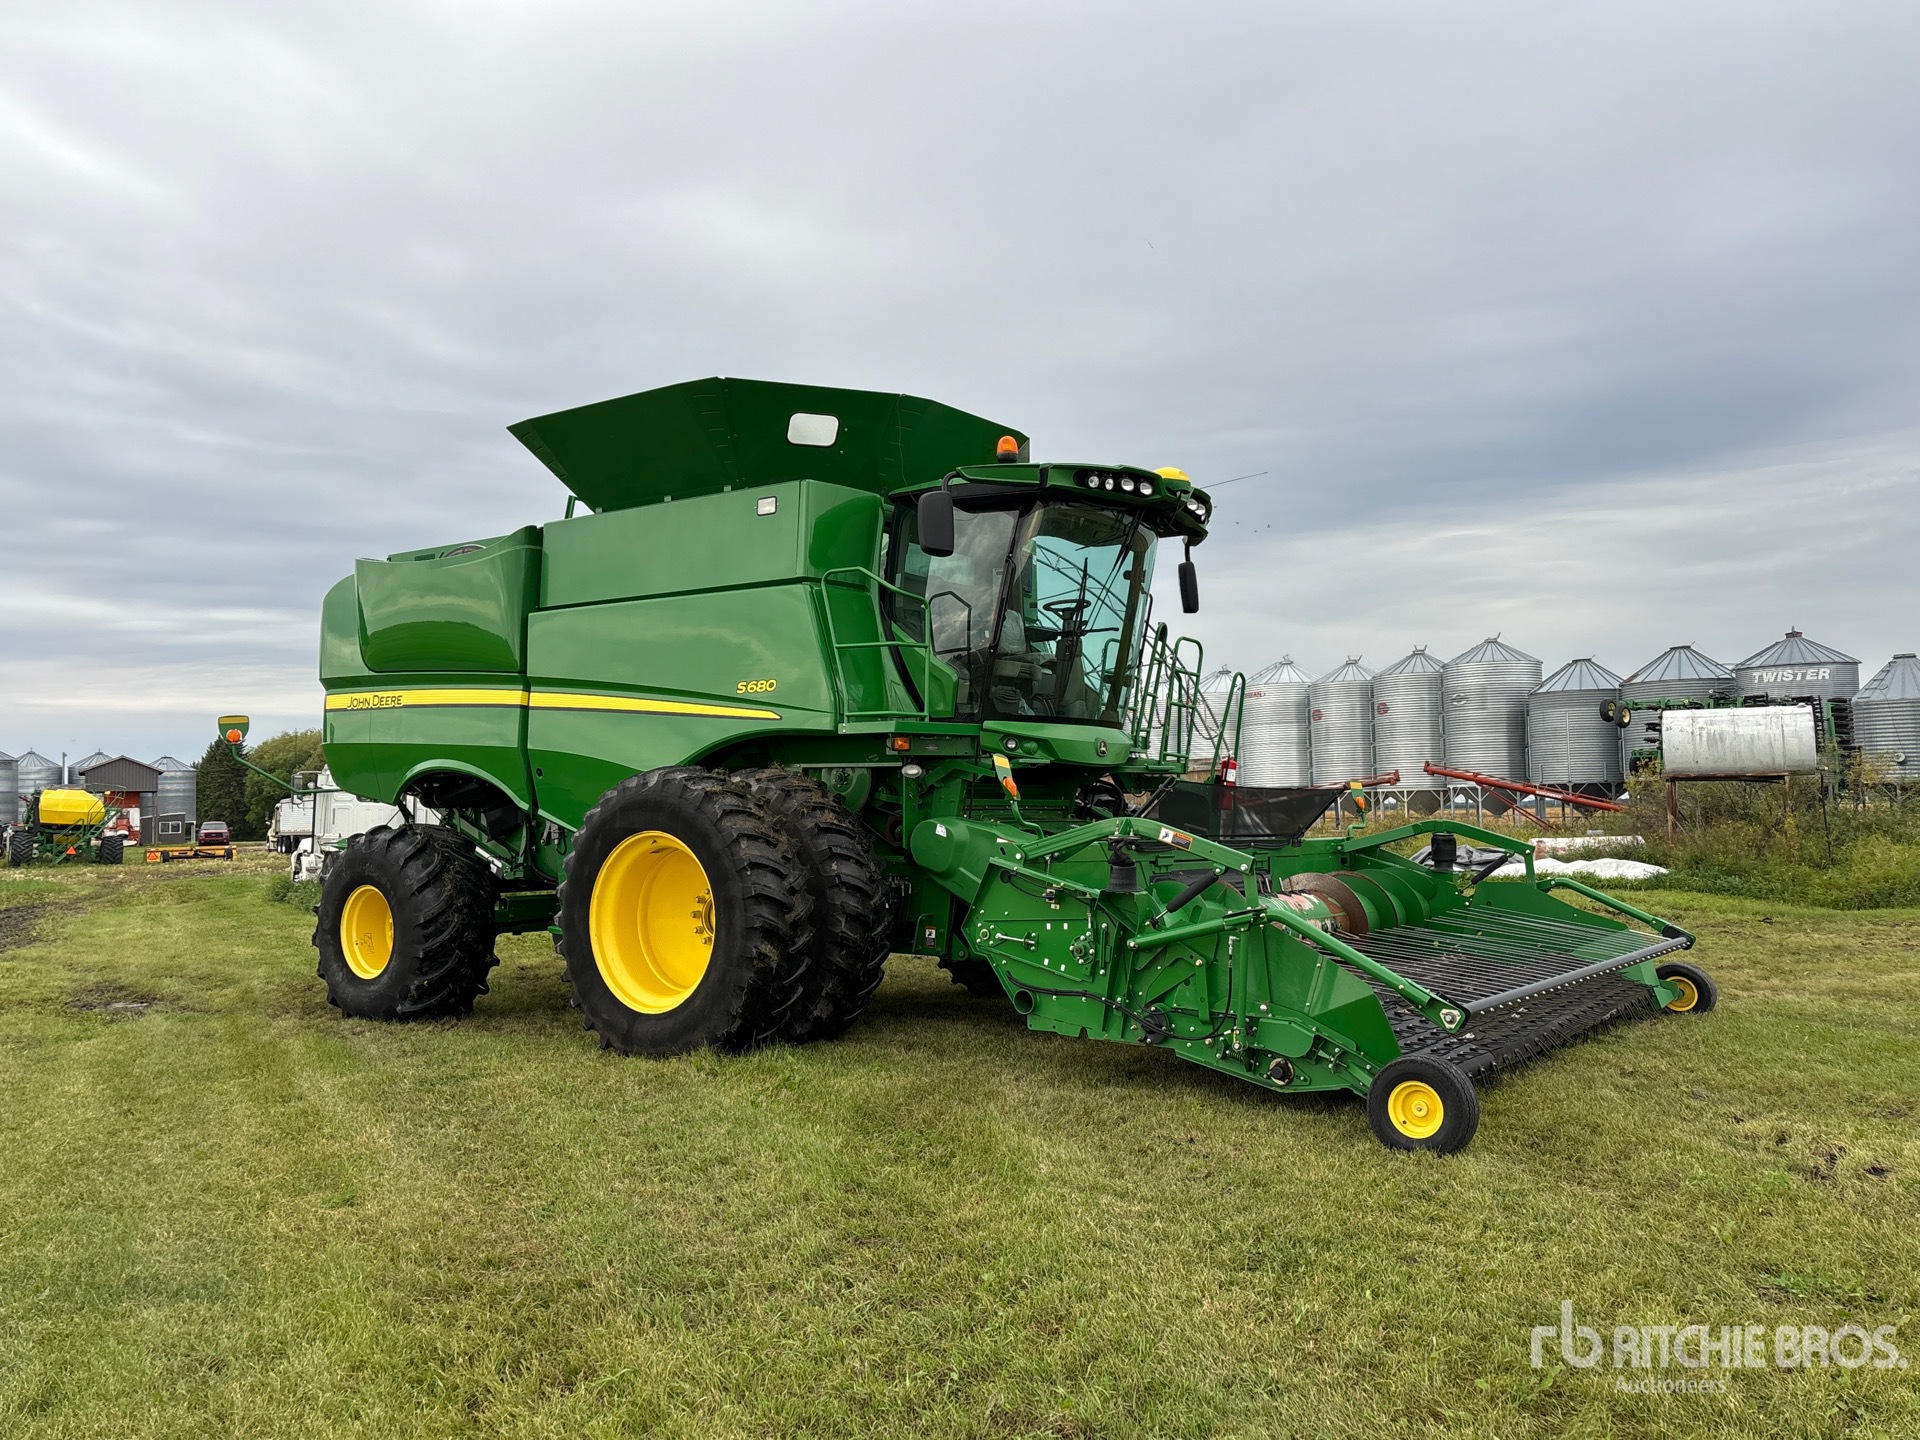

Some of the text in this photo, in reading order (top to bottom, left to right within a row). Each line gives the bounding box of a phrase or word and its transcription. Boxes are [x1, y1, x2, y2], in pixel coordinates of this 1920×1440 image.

[1753, 668, 1830, 683] TWISTER
[736, 679, 777, 694] S680
[347, 694, 403, 709] JOHN DEERE
